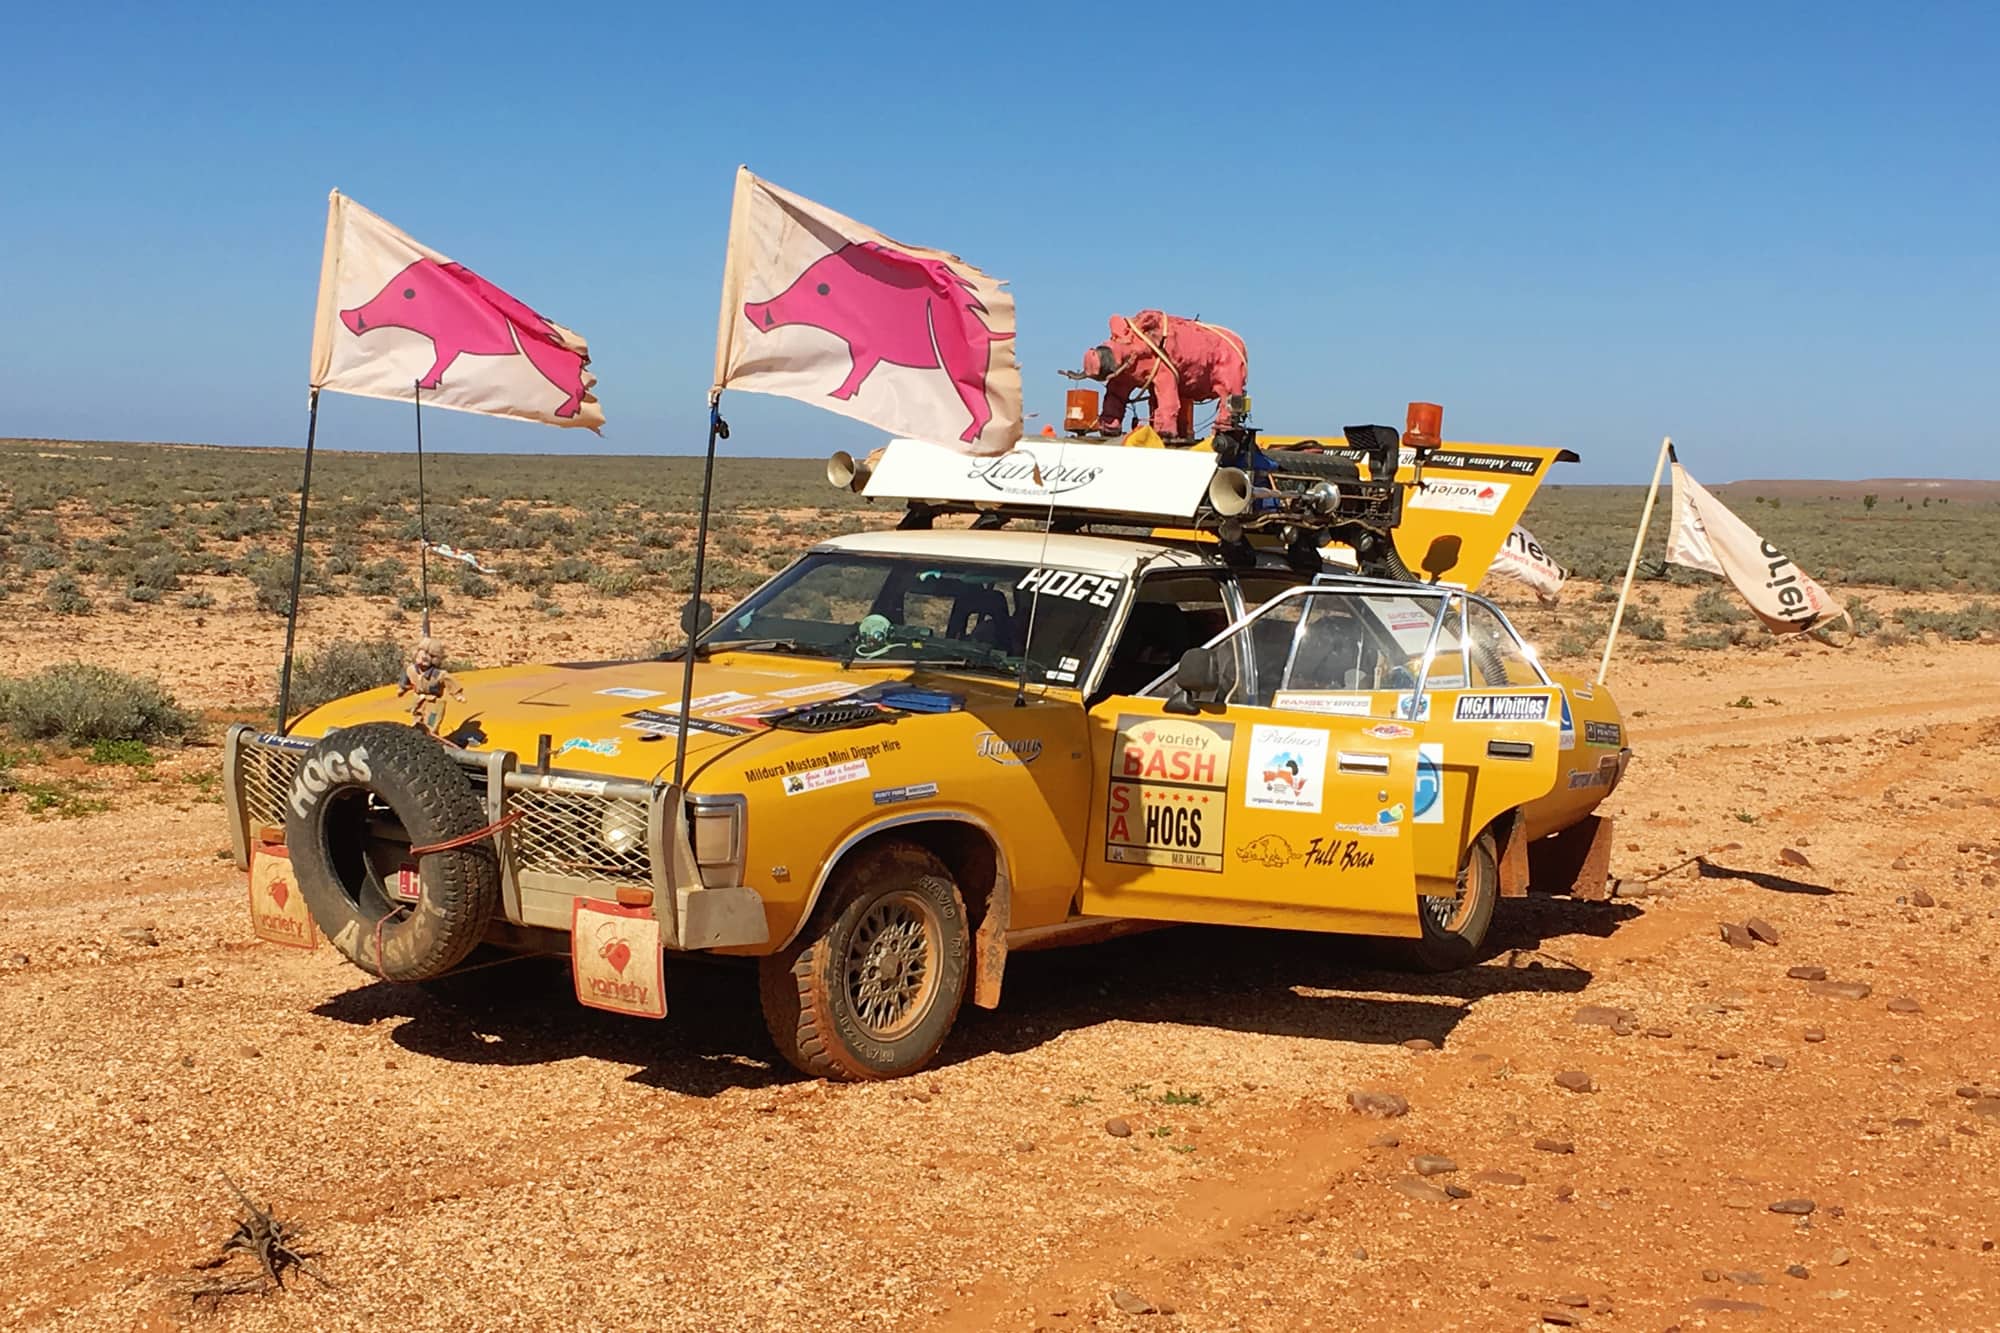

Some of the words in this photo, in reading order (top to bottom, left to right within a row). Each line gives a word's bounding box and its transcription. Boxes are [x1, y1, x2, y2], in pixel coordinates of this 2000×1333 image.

[1431, 453, 1465, 467] Wines
[1468, 457, 1509, 470] Adams
[1510, 459, 1534, 473] Tim
[1016, 567, 1121, 609] HOGS
[1460, 697, 1490, 715] MGA
[1493, 697, 1545, 716] Whittles
[1157, 732, 1210, 749] variety
[1257, 728, 1322, 748] Palmers
[744, 764, 786, 784] Mildura
[785, 754, 830, 774] Mustang
[828, 748, 850, 764] Mini
[850, 742, 881, 760] Digger
[881, 739, 902, 753] Hire
[1123, 747, 1217, 783] BASH
[288, 745, 373, 820] HOGS
[1146, 804, 1202, 849] HOGS
[1304, 836, 1341, 868] Full
[588, 975, 649, 1006] variety
